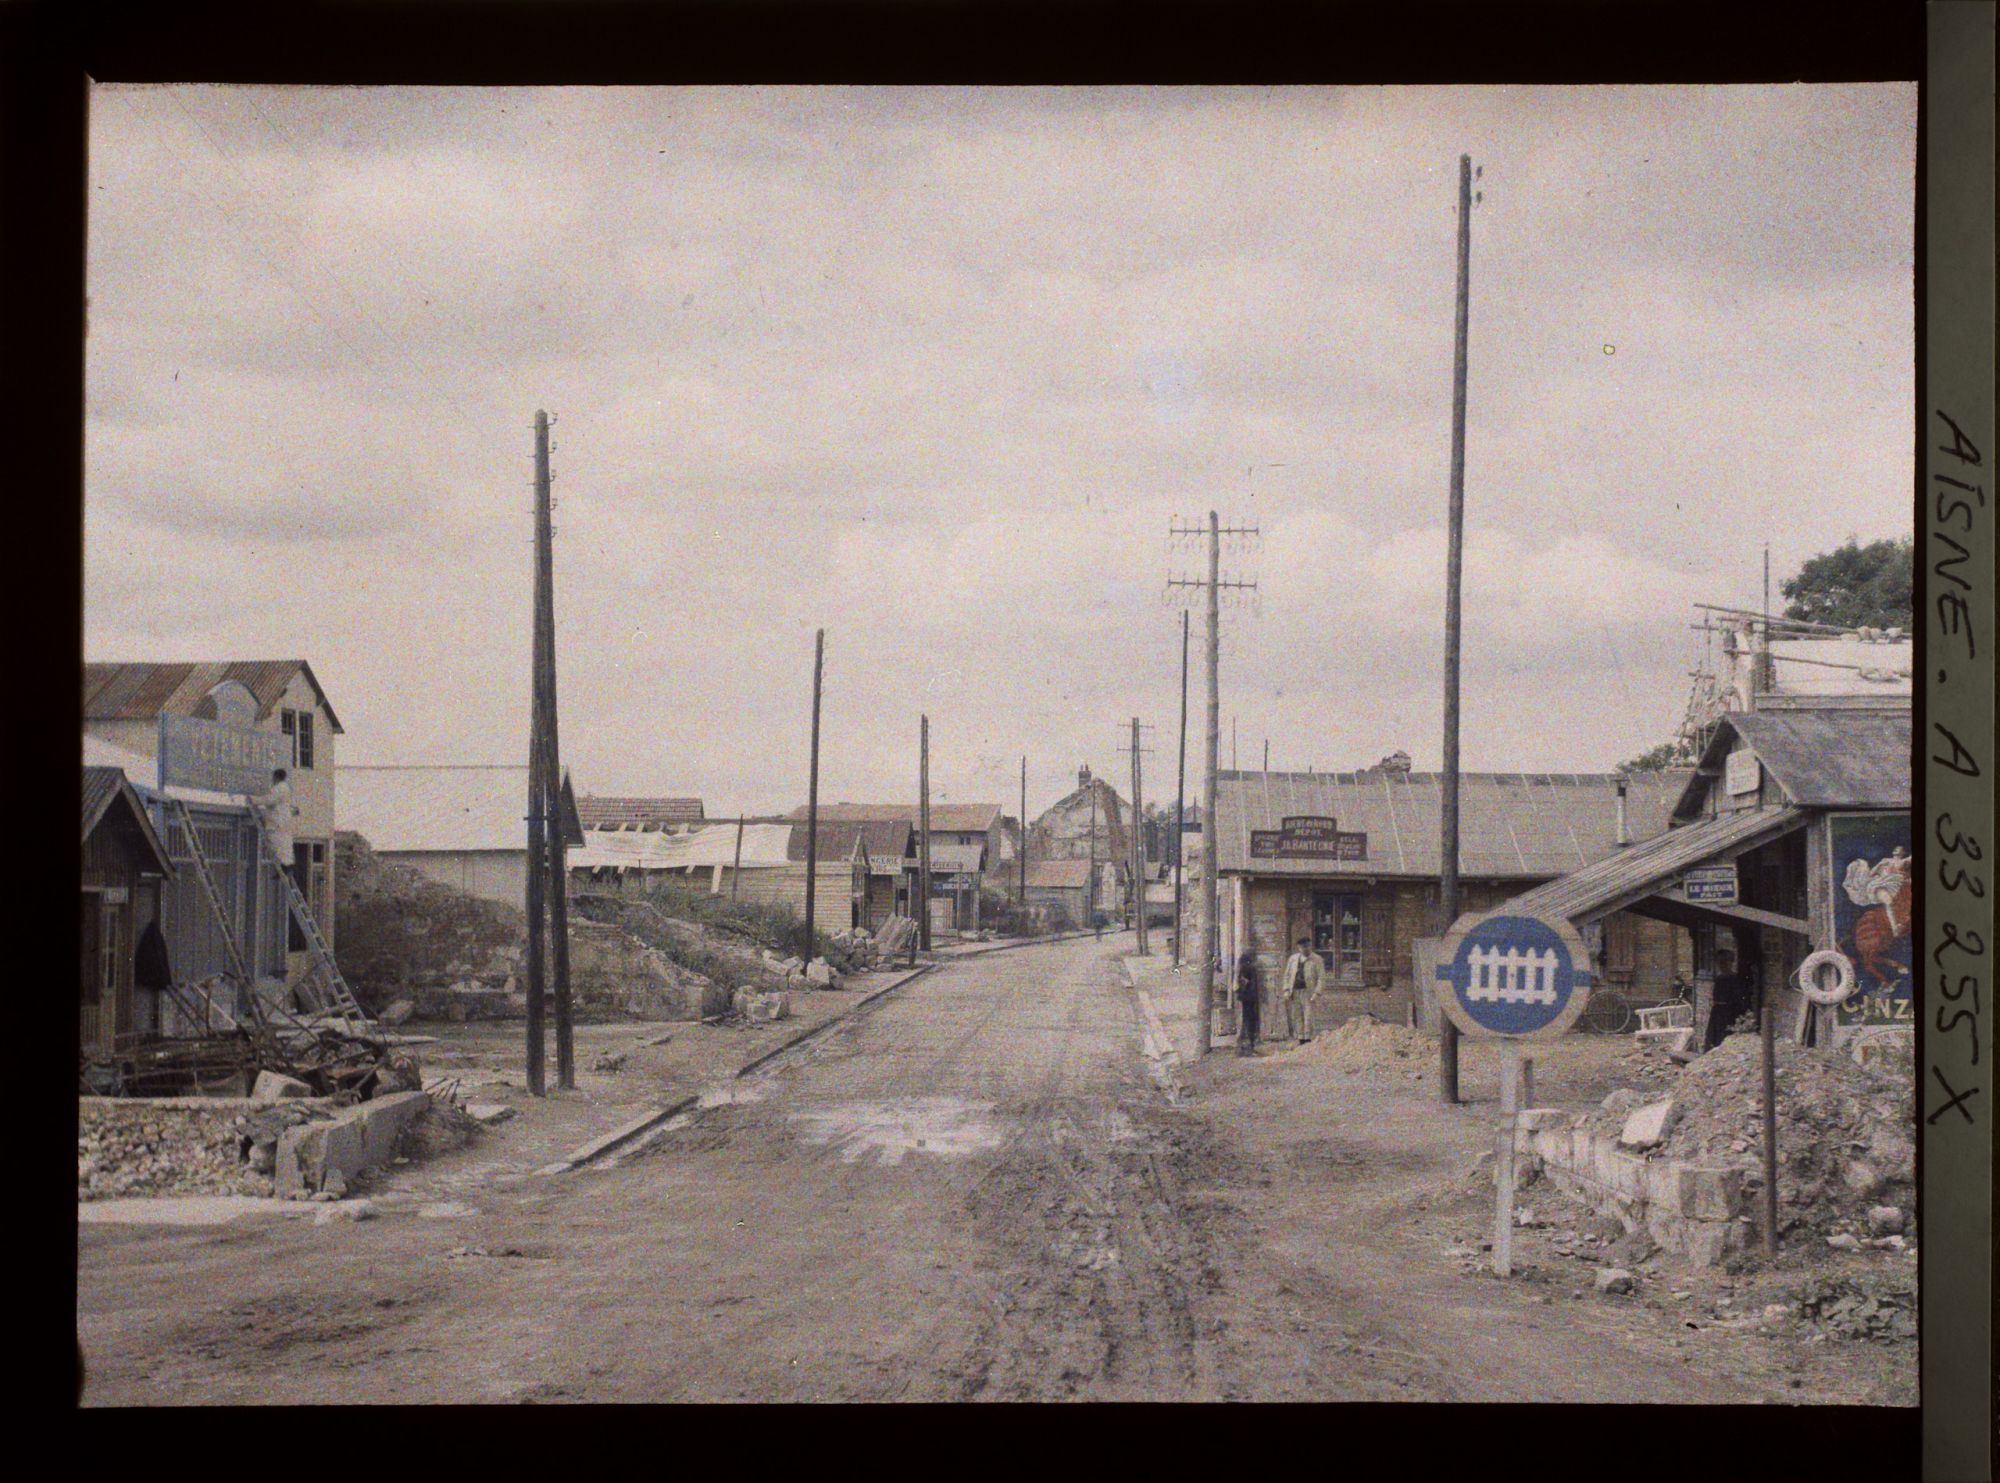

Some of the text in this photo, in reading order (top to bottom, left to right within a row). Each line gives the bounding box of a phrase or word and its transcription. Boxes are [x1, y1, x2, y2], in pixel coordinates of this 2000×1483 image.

[1932, 721, 1981, 778] A
[1841, 995, 1915, 1019] CINZ
[1927, 1064, 1980, 1126] X
